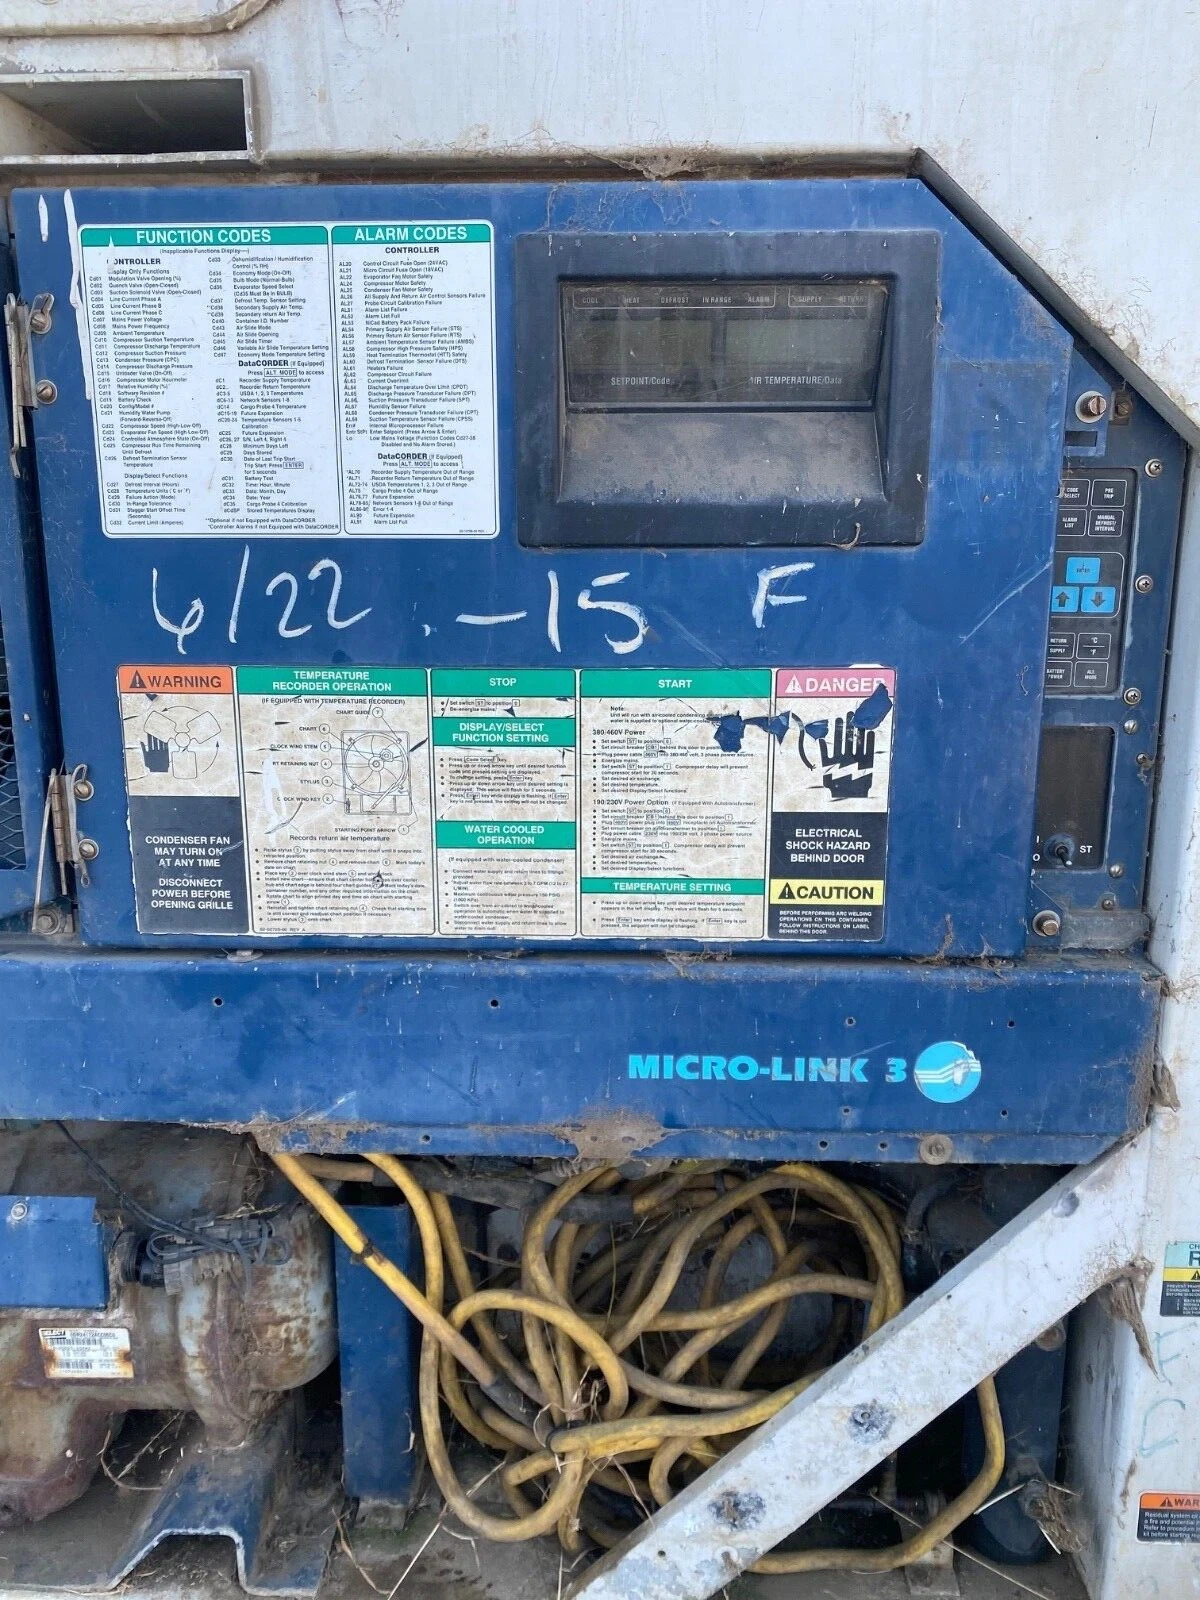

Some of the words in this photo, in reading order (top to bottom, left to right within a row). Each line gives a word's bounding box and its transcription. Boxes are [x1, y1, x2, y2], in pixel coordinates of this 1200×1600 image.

[136, 230, 213, 244] FUNCTION
[218, 229, 271, 243] CODES
[354, 228, 408, 241] ALARM
[413, 226, 467, 240] CODES
[610, 376, 670, 386] SETPOINT/Code
[765, 376, 842, 385] TEMPERATURE/Data
[151, 543, 371, 655] 6/22
[755, 561, 816, 629] F
[293, 671, 370, 681] TEMPERATURE
[148, 675, 222, 688] WARNING
[489, 678, 517, 687] STOP
[658, 680, 692, 689] START
[272, 682, 330, 691] RECORDER
[332, 682, 392, 692] OPERATION
[460, 722, 544, 732] DISPLAY/SELECT
[452, 733, 503, 742] FUNCTION
[506, 733, 549, 743] SETTING
[464, 825, 500, 834] WATER
[503, 825, 544, 834] COOLED
[795, 829, 862, 837] ELECTRICAL
[145, 836, 208, 844] CONDENSER
[210, 836, 230, 845] FAN
[477, 836, 535, 844] OPERATION
[785, 842, 824, 850] SHOCK
[826, 842, 871, 850] HAZARD
[1080, 845, 1092, 854] ST
[154, 847, 175, 856] MAY
[178, 847, 205, 856] TURN
[208, 848, 223, 856] ON
[158, 858, 171, 867] AT
[174, 858, 194, 867] ANY
[196, 859, 220, 867] TIME
[790, 854, 831, 862] BEHIND
[833, 854, 865, 863] DOOR
[158, 878, 222, 888] DISCONNECT
[613, 882, 686, 891] TEMPERATURE
[689, 883, 732, 892] SETTING
[152, 890, 188, 898] POWER
[190, 890, 231, 899] BEFORE
[796, 886, 874, 900] CAUTION
[151, 900, 195, 909] OPENING
[198, 901, 234, 910] GRILLE
[628, 1054, 870, 1083] MICRO-LINK
[885, 1058, 908, 1083] 3
[1175, 1498, 1200, 1506] WAR
